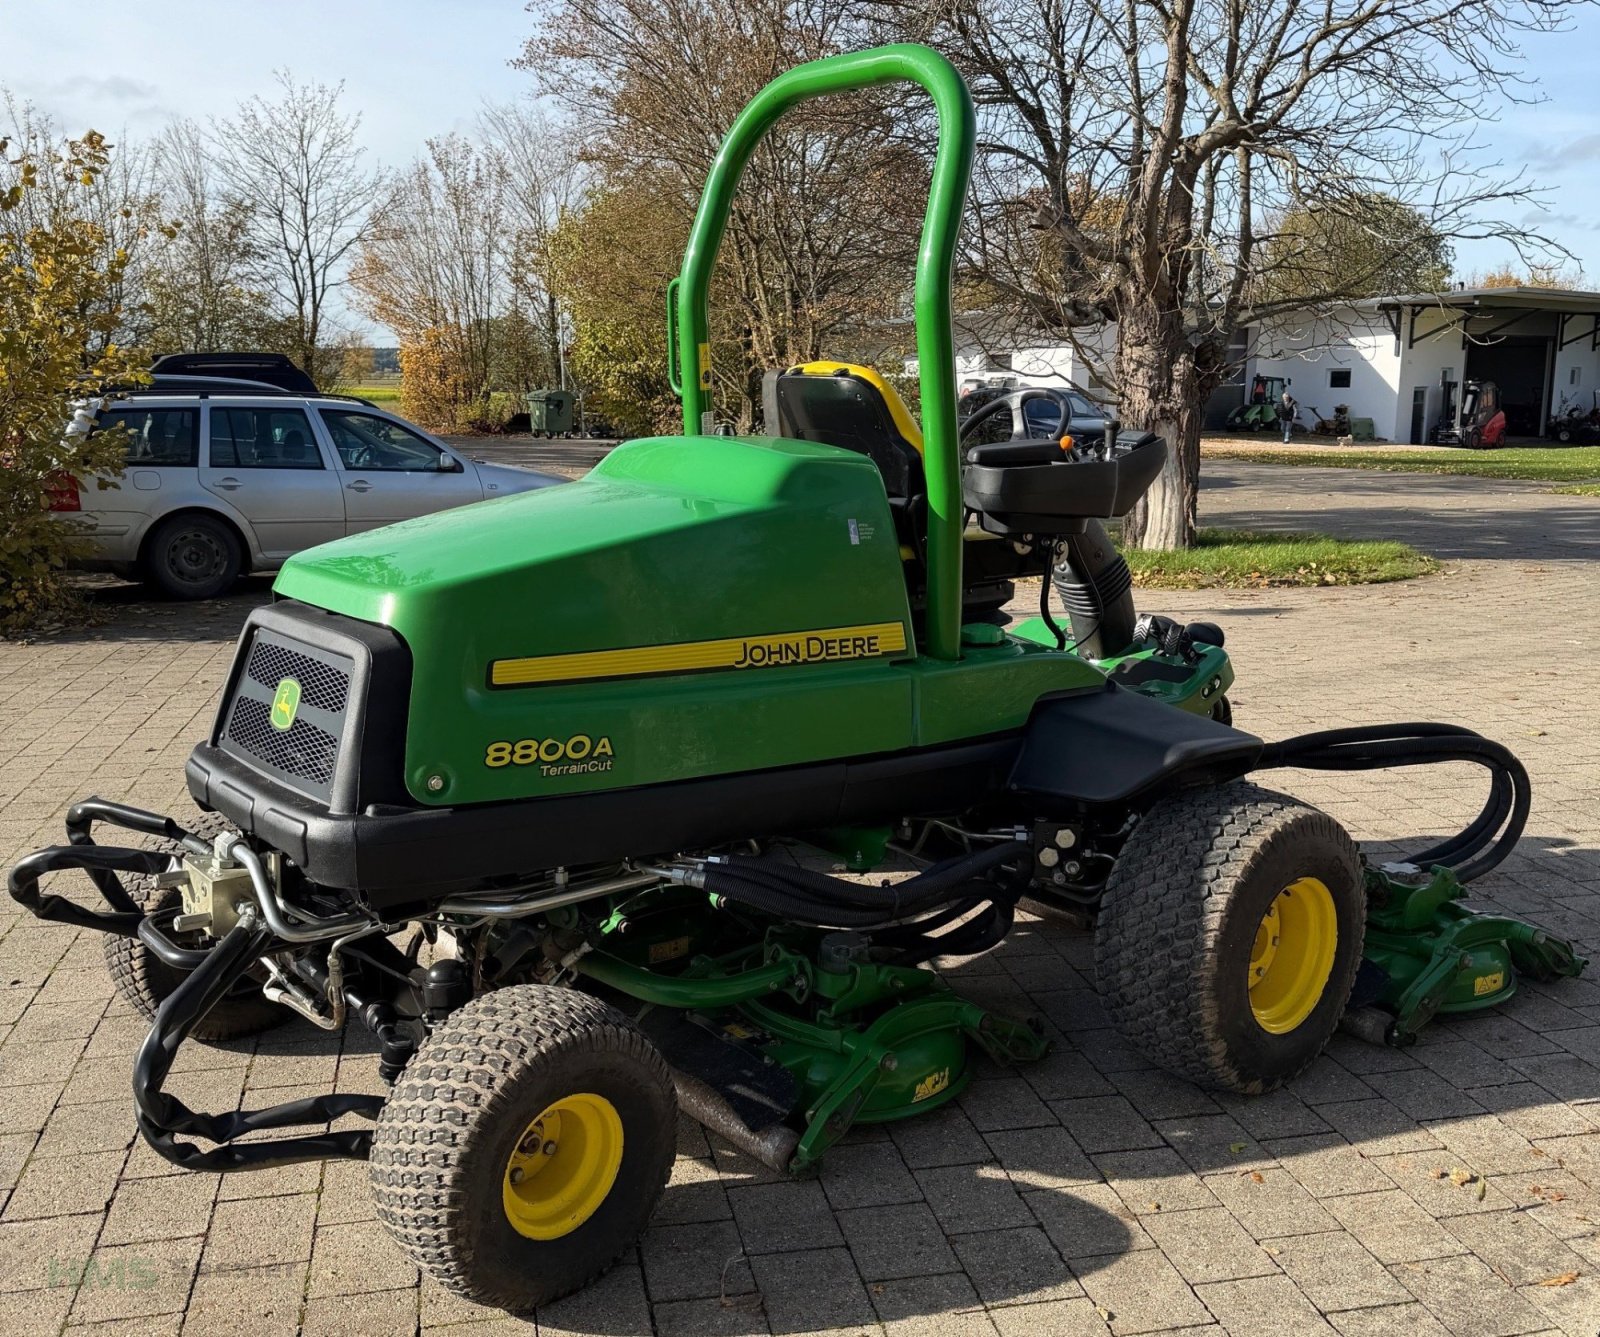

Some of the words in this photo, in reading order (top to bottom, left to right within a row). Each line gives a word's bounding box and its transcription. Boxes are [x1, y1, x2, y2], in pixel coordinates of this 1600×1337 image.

[734, 641, 801, 666] JOHN
[806, 635, 880, 659] DEERE
[484, 734, 614, 768] 8800A
[540, 759, 613, 777] TerrainCut
